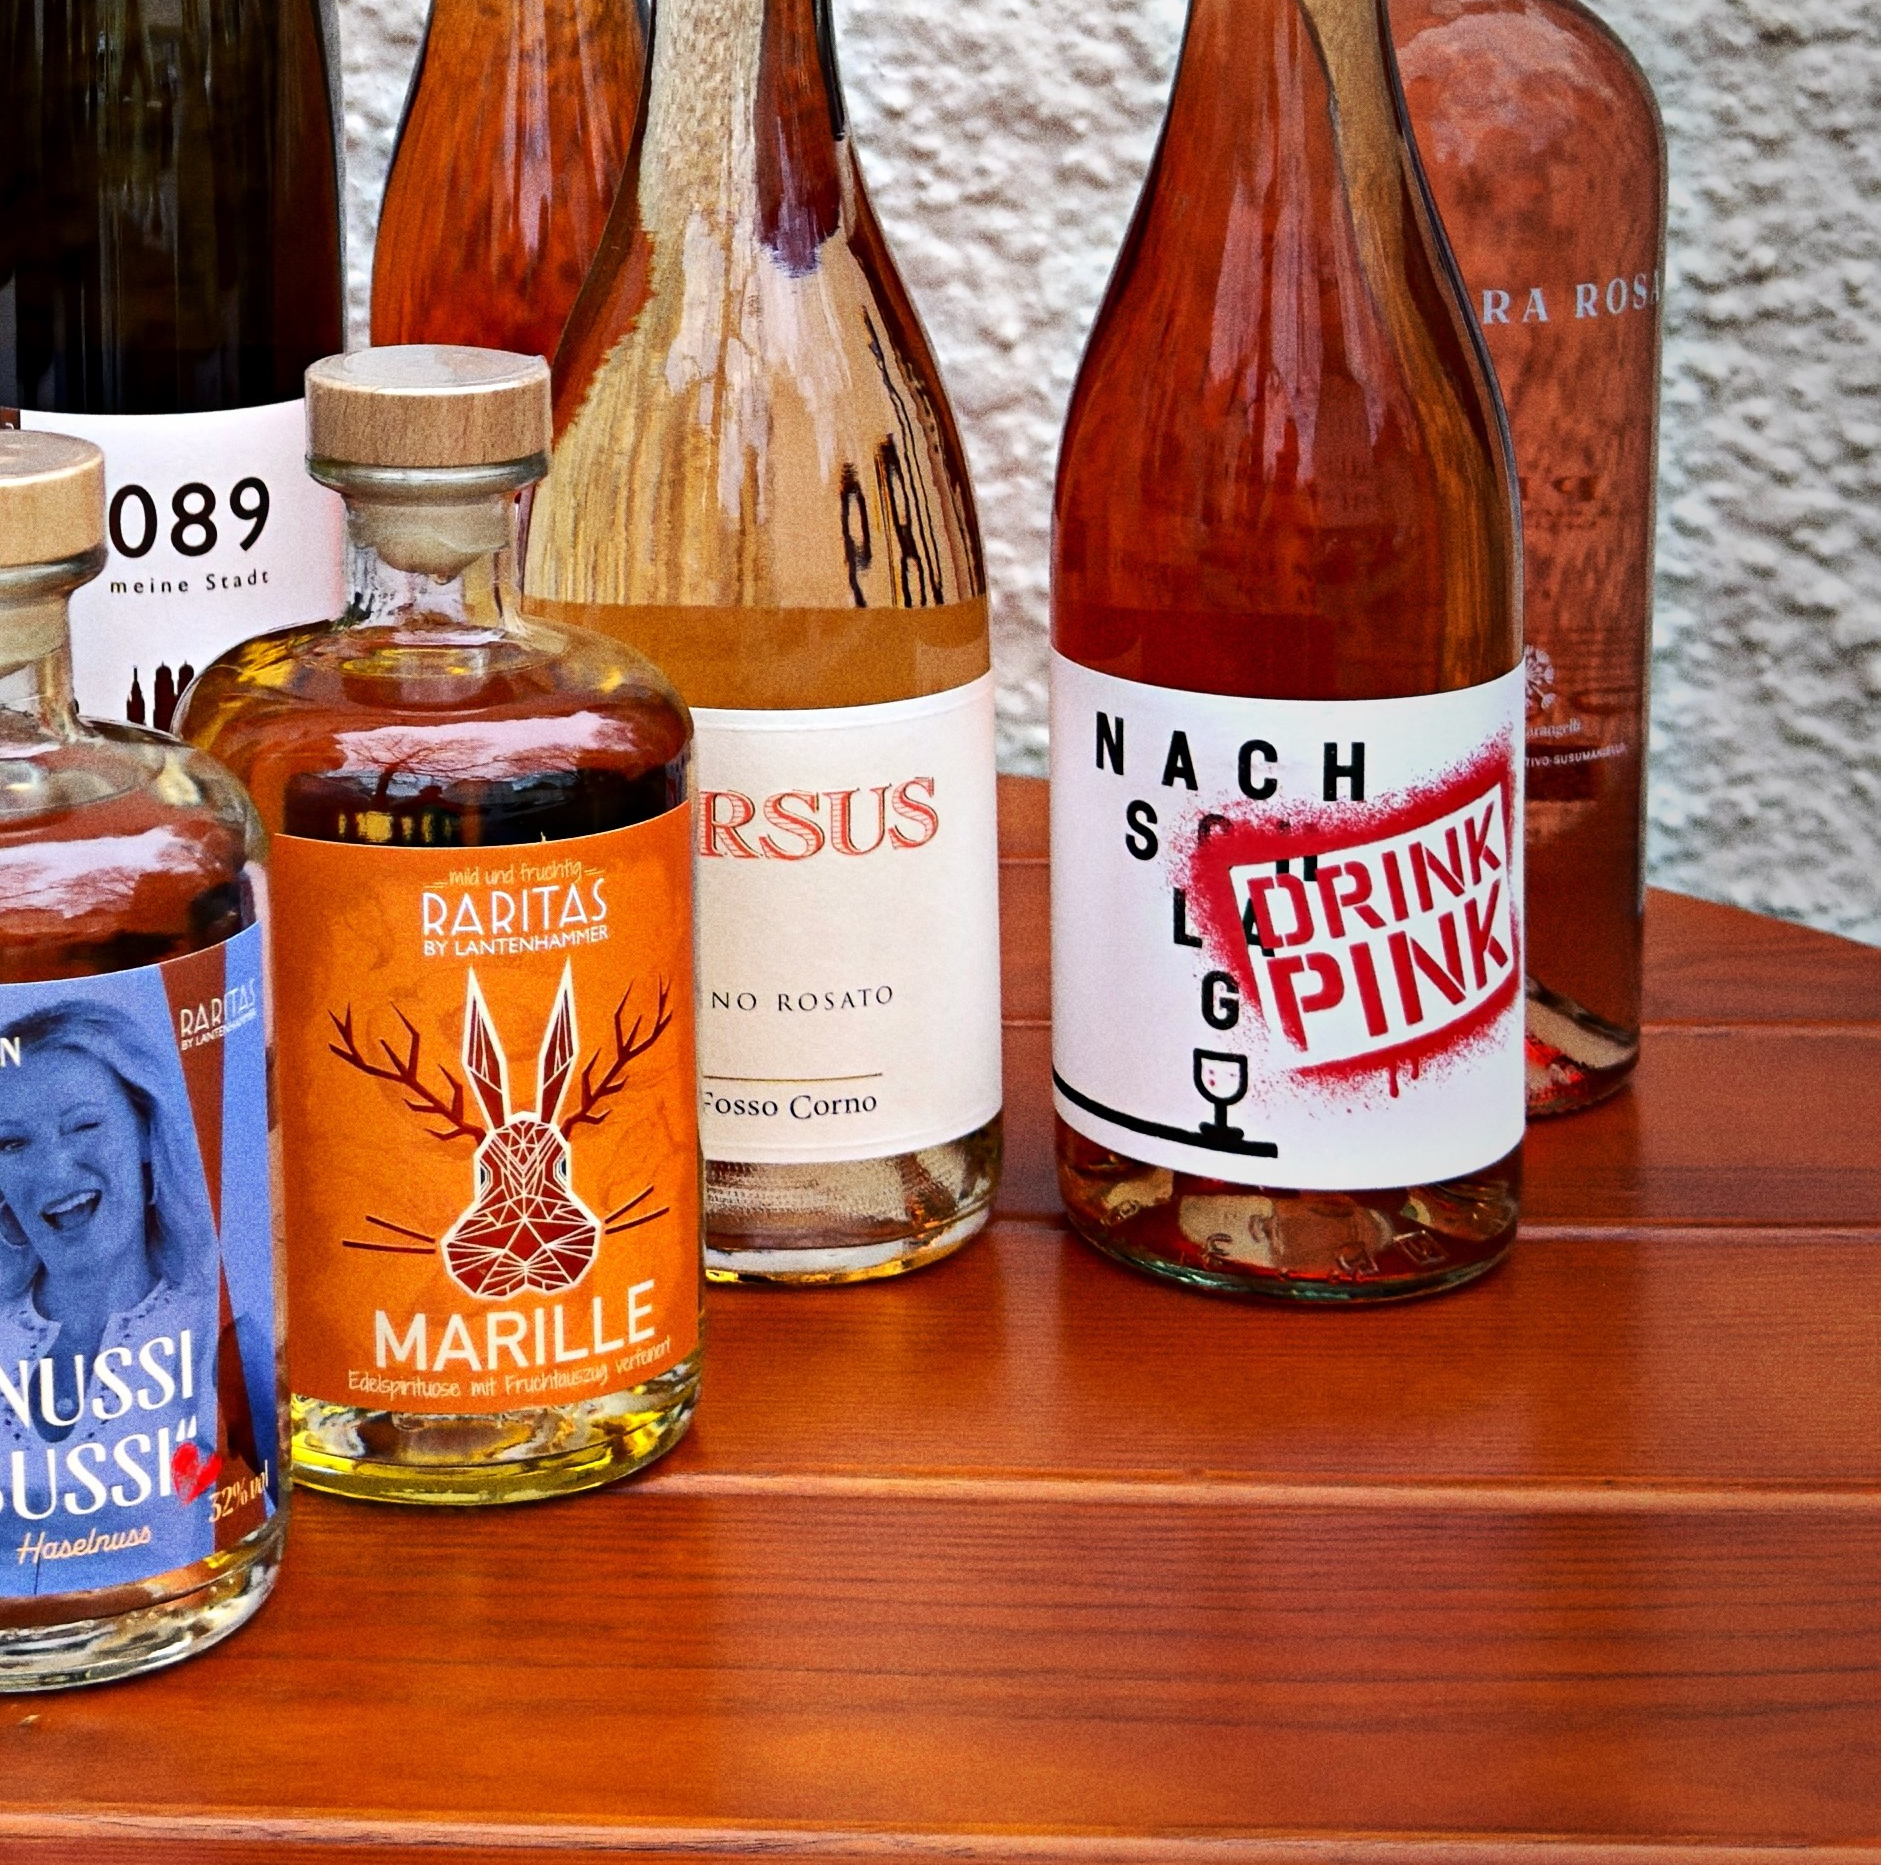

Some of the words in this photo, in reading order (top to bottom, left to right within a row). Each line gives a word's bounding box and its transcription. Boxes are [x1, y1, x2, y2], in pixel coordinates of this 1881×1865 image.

[1482, 286, 1549, 325] RA
[1575, 269, 1661, 319] ROSA
[108, 476, 270, 559] 089
[110, 578, 189, 594] meine
[206, 569, 270, 591] Stadt
[1095, 711, 1366, 802] NACH
[698, 776, 940, 861] RSUS
[449, 866, 480, 886] mild
[485, 864, 515, 885] und
[1246, 800, 1503, 952] DRINK
[422, 877, 607, 936] RARITAS
[423, 940, 449, 957] BY
[455, 924, 609, 957] LANTENHAMMER
[1266, 878, 1510, 1053] PINK
[777, 985, 894, 1012] ROSATO
[789, 1095, 877, 1120] Corno
[375, 1279, 656, 1373] MARILLE
[348, 1369, 462, 1401] Edelspirituose
[471, 1379, 495, 1398] mit
[505, 1364, 609, 1396] Fruchtauszug
[16, 1525, 152, 1565] Haselnuss
